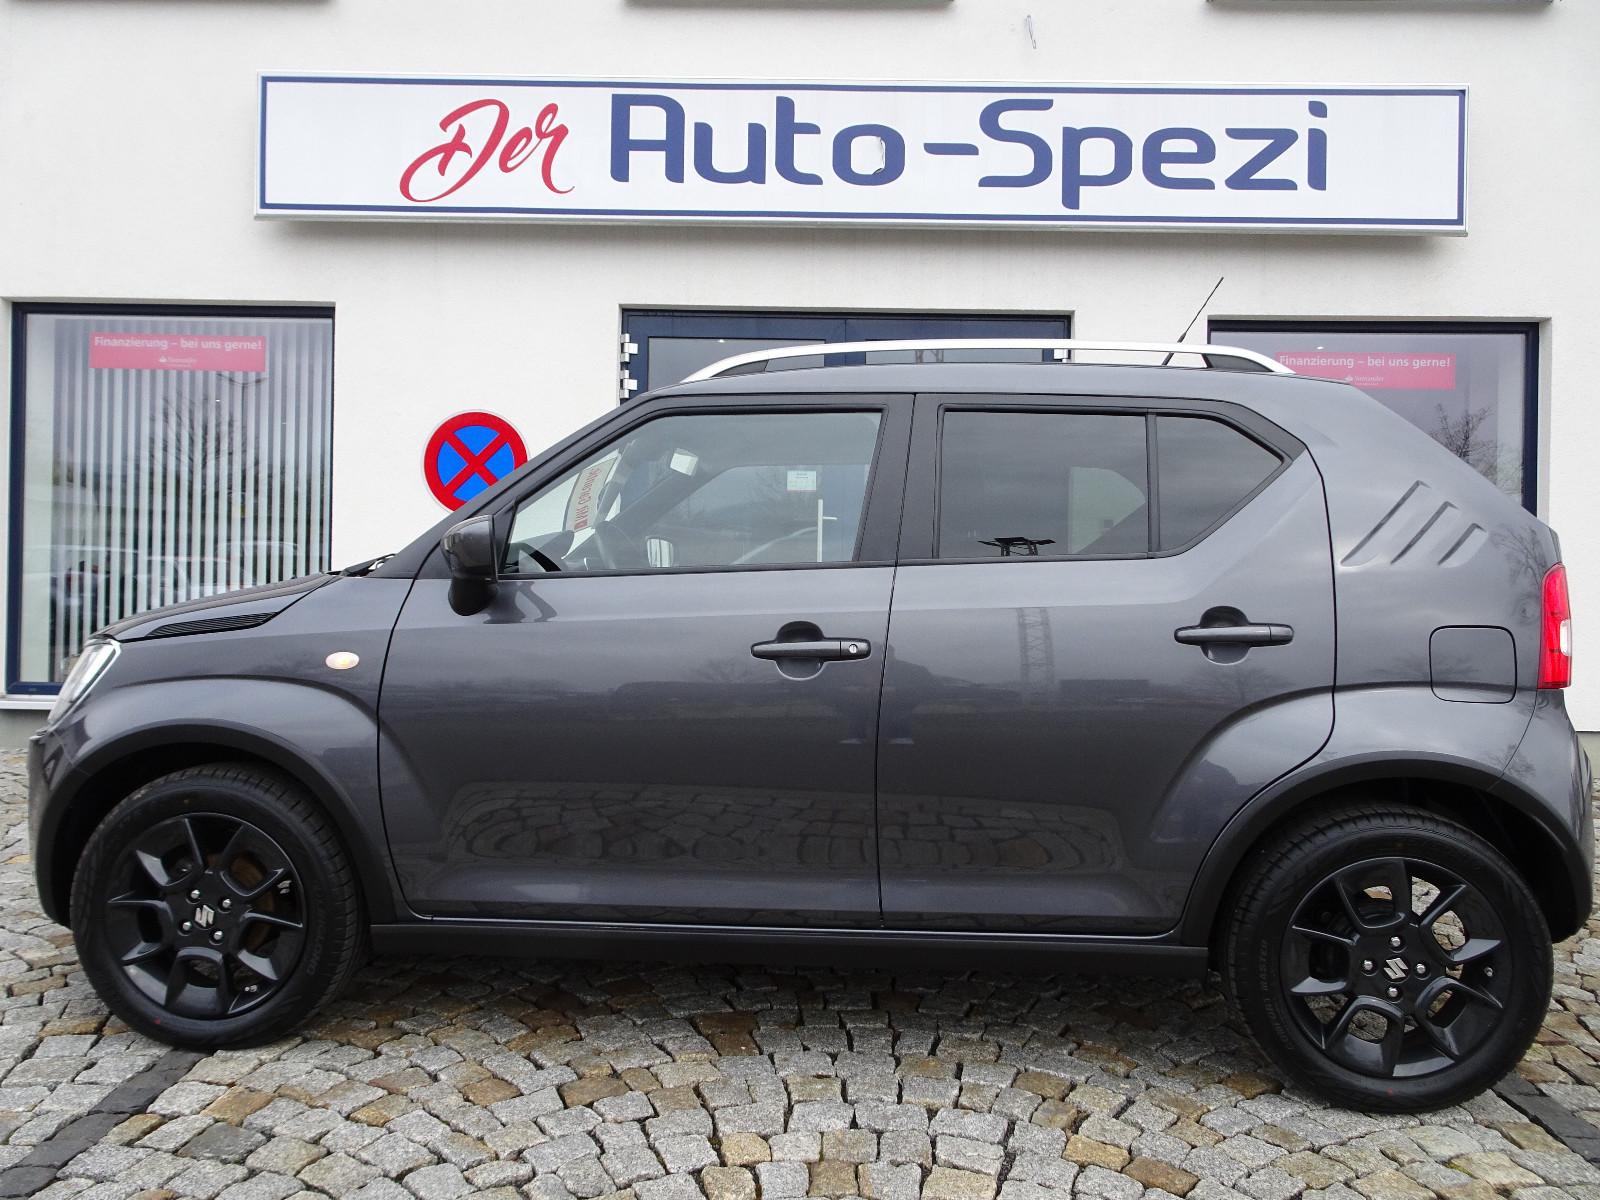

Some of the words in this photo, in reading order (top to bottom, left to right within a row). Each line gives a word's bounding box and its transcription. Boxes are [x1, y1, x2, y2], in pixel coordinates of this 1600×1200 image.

[399, 98, 575, 203] Der
[94, 336, 169, 350] Finanzierung
[180, 338, 198, 348] bei
[201, 340, 222, 349] uns
[224, 339, 262, 351] gerne!
[1279, 355, 1354, 369] Finanzierung
[1367, 356, 1385, 367] bei
[1388, 358, 1409, 367] uns
[1412, 356, 1451, 369] gerne!
